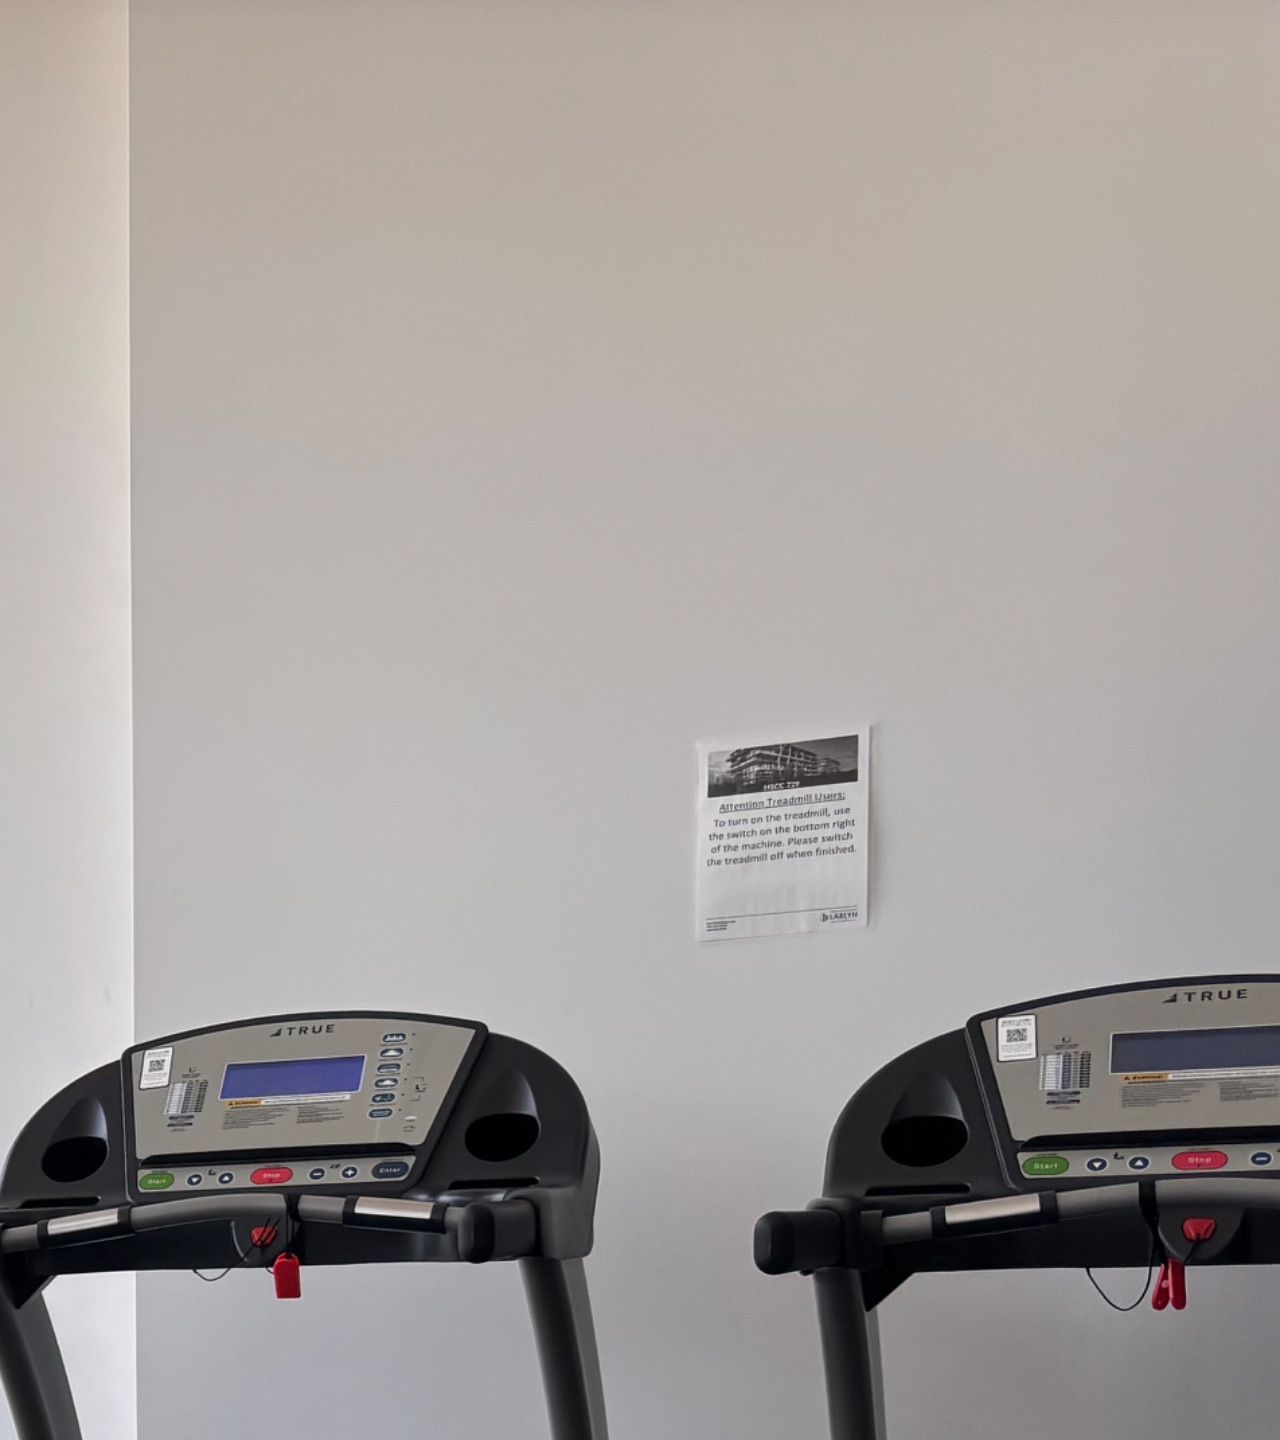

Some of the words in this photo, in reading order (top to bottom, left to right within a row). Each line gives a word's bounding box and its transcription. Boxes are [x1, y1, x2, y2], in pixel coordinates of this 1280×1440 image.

[719, 801, 764, 813] Attention
[766, 794, 812, 808] Treadmill
[713, 819, 726, 828] To
[728, 818, 748, 827] turn
[750, 816, 763, 824] on
[765, 814, 781, 823] the
[784, 808, 831, 820] treadmill,
[834, 807, 851, 816] use
[708, 832, 724, 841] the
[726, 829, 757, 839] switch
[760, 828, 772, 836] on
[775, 826, 790, 834] the
[793, 822, 830, 833] bottom
[832, 819, 855, 829] right
[710, 845, 720, 854] of
[723, 844, 739, 853] the
[741, 840, 784, 851] machine.
[787, 836, 819, 846] Please
[821, 832, 853, 842] switch
[706, 858, 722, 867] the
[724, 853, 768, 865] treadmill
[769, 851, 784, 861] off
[786, 850, 813, 859] when
[815, 844, 857, 856] finished.
[1183, 989, 1249, 1002] TRUE
[286, 1023, 336, 1037] TRUE
[1033, 1161, 1059, 1170] Start
